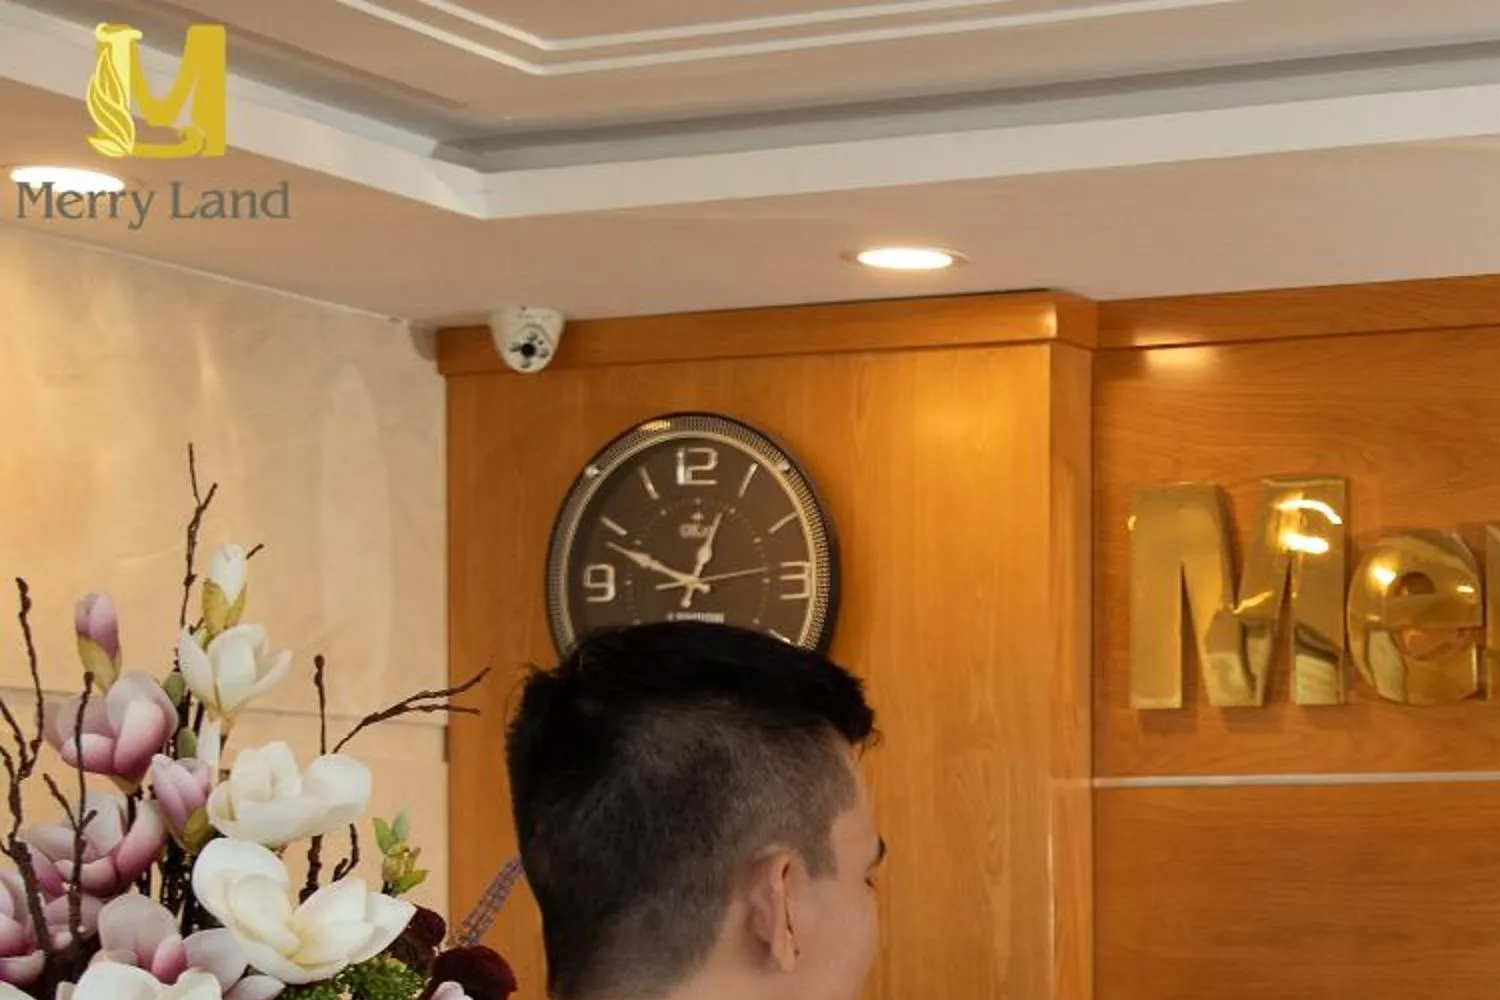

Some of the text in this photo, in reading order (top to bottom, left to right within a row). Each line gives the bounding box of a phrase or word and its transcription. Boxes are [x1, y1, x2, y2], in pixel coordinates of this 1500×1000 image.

[676, 447, 718, 485] 12
[584, 563, 615, 603] 9
[780, 561, 811, 600] 3
